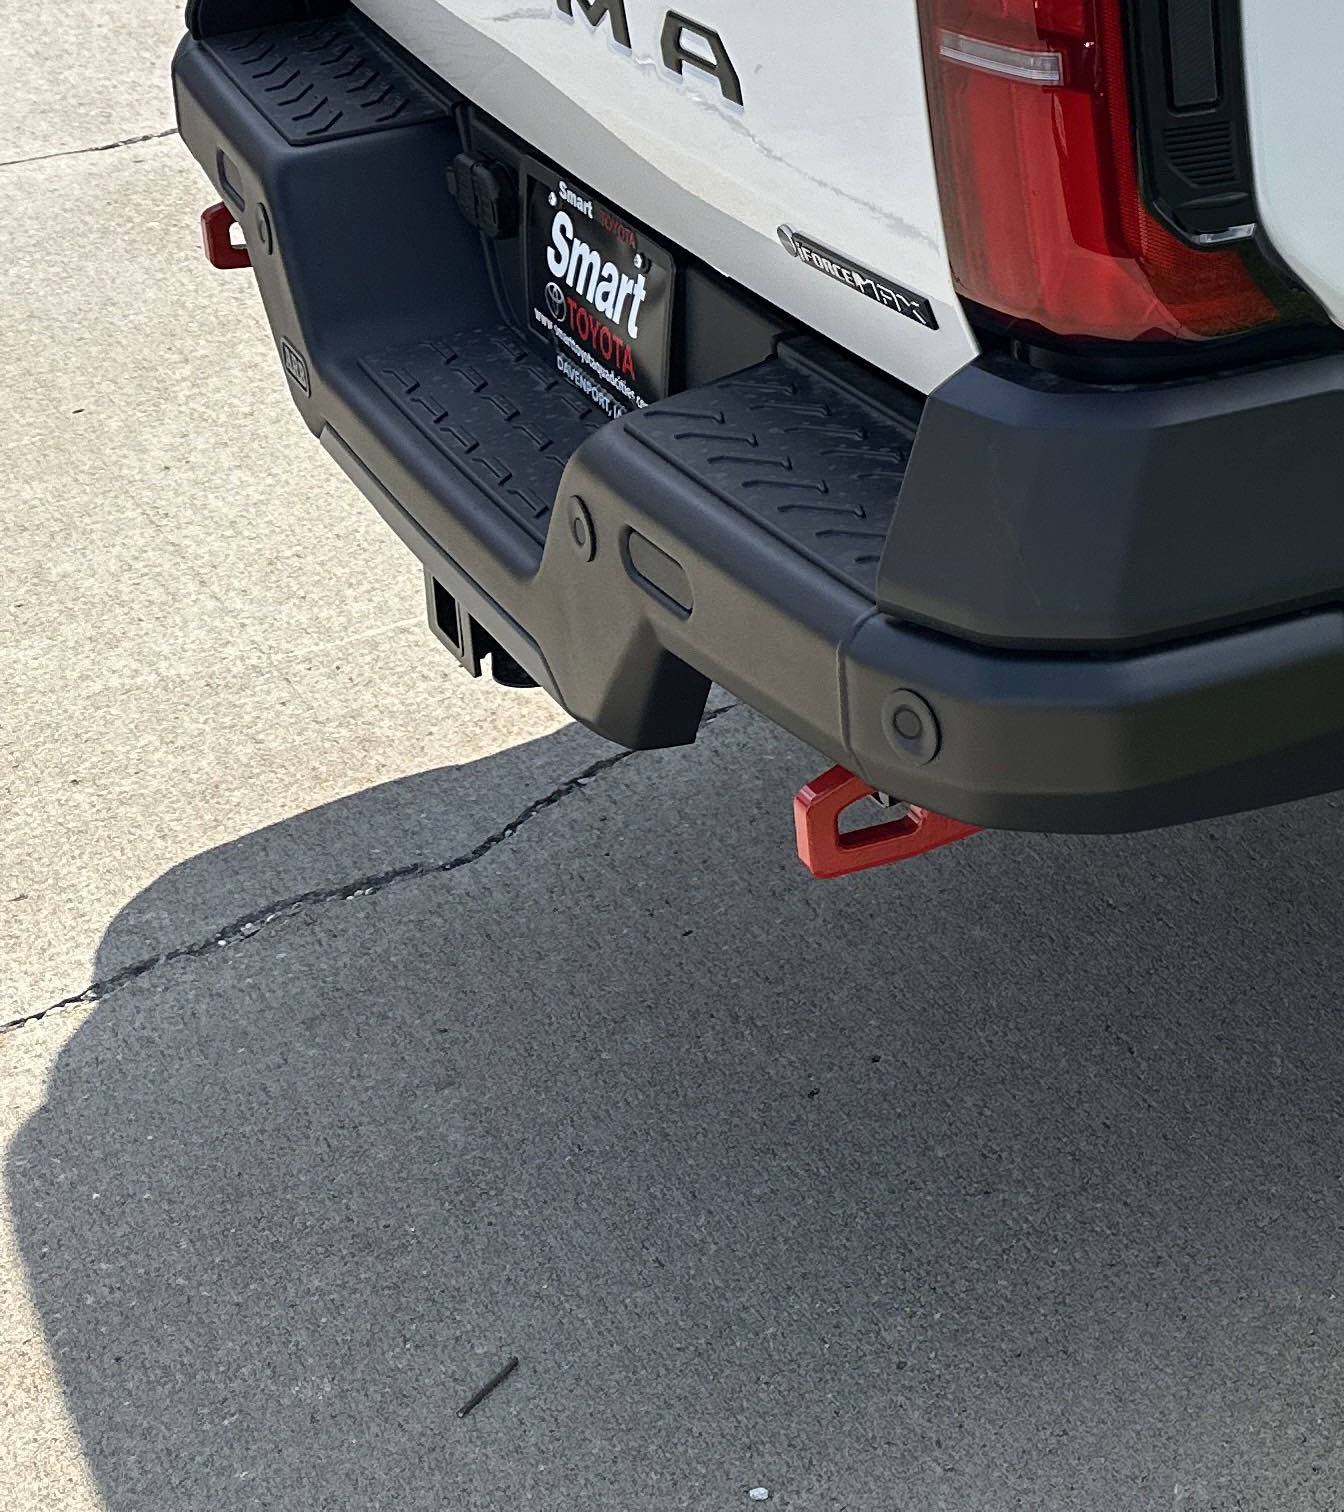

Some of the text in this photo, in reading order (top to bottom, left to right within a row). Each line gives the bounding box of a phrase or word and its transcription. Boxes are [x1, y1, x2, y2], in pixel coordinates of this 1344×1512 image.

[558, 180, 638, 250] Smart TOYOTA
[546, 210, 647, 339] Smart
[851, 271, 927, 325] MAX
[566, 296, 636, 380] TOYOTA
